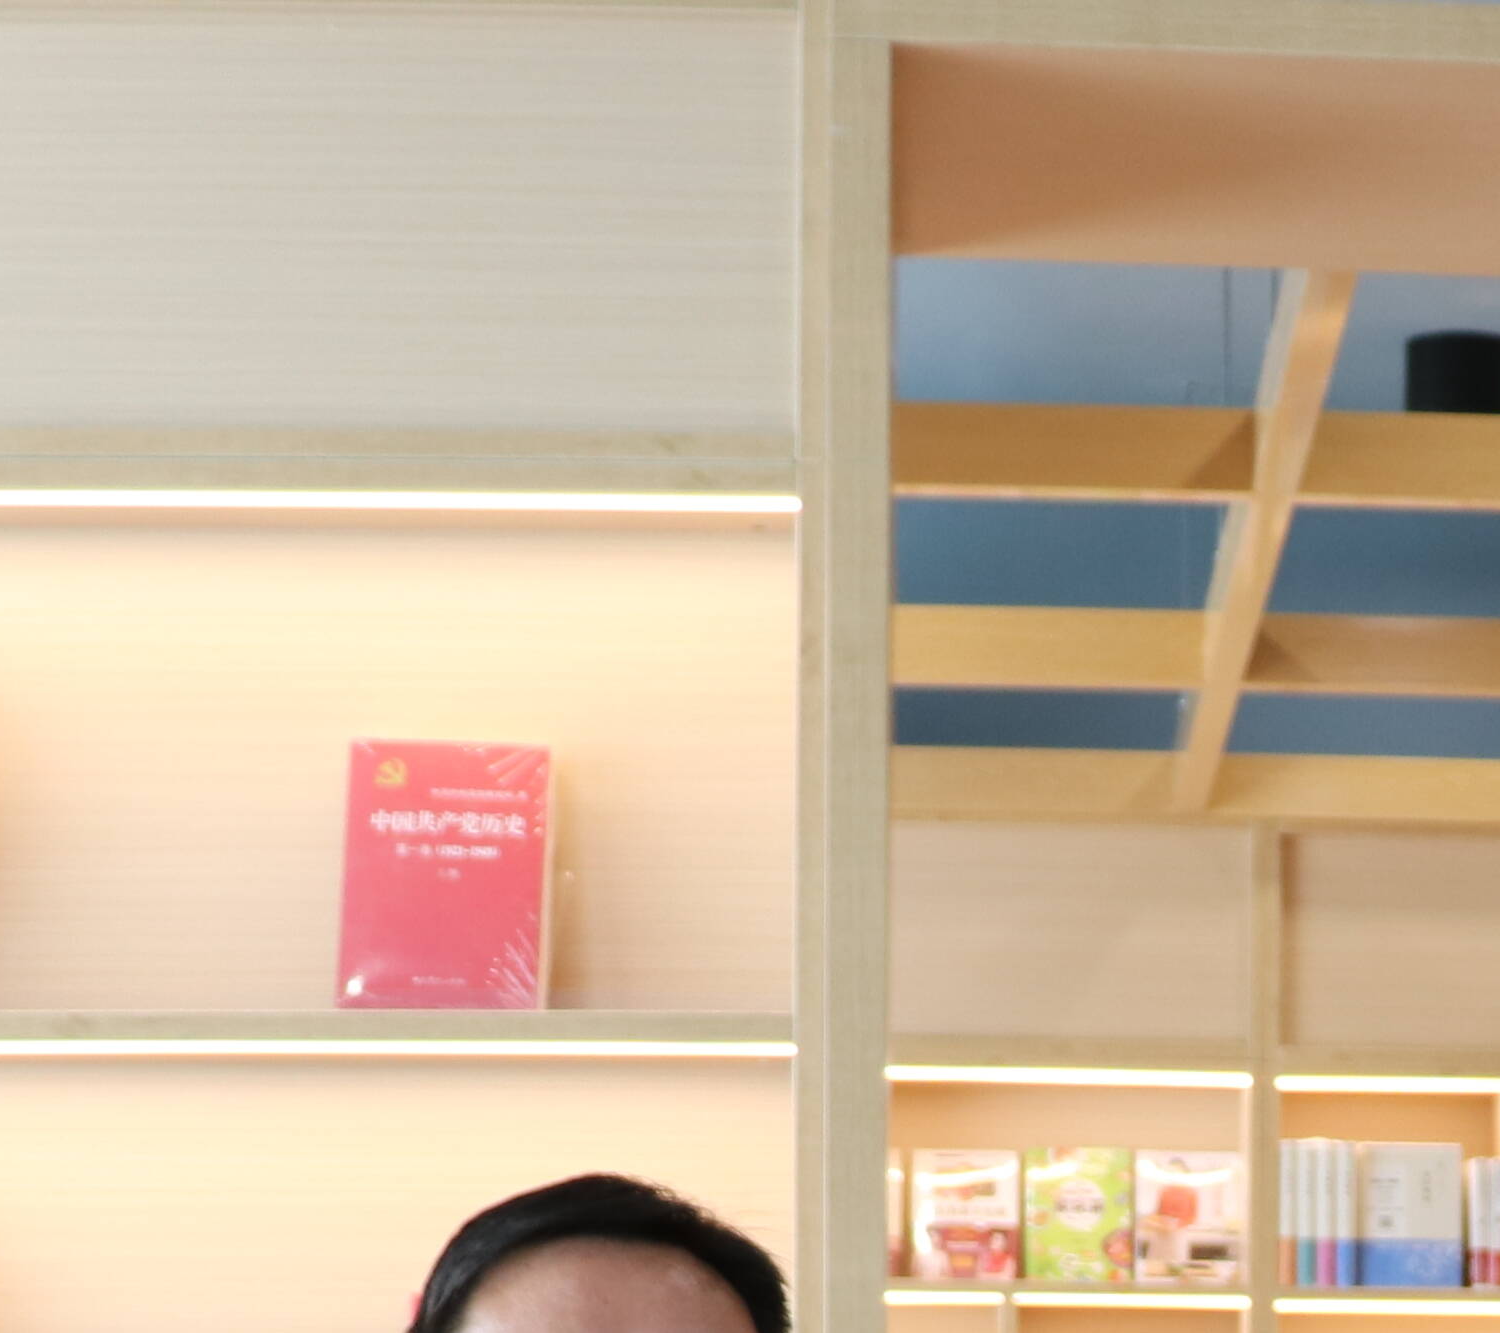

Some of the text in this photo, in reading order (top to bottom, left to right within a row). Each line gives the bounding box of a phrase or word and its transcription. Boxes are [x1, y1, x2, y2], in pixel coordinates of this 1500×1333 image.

[370, 809, 527, 839] 中国共产党历史
